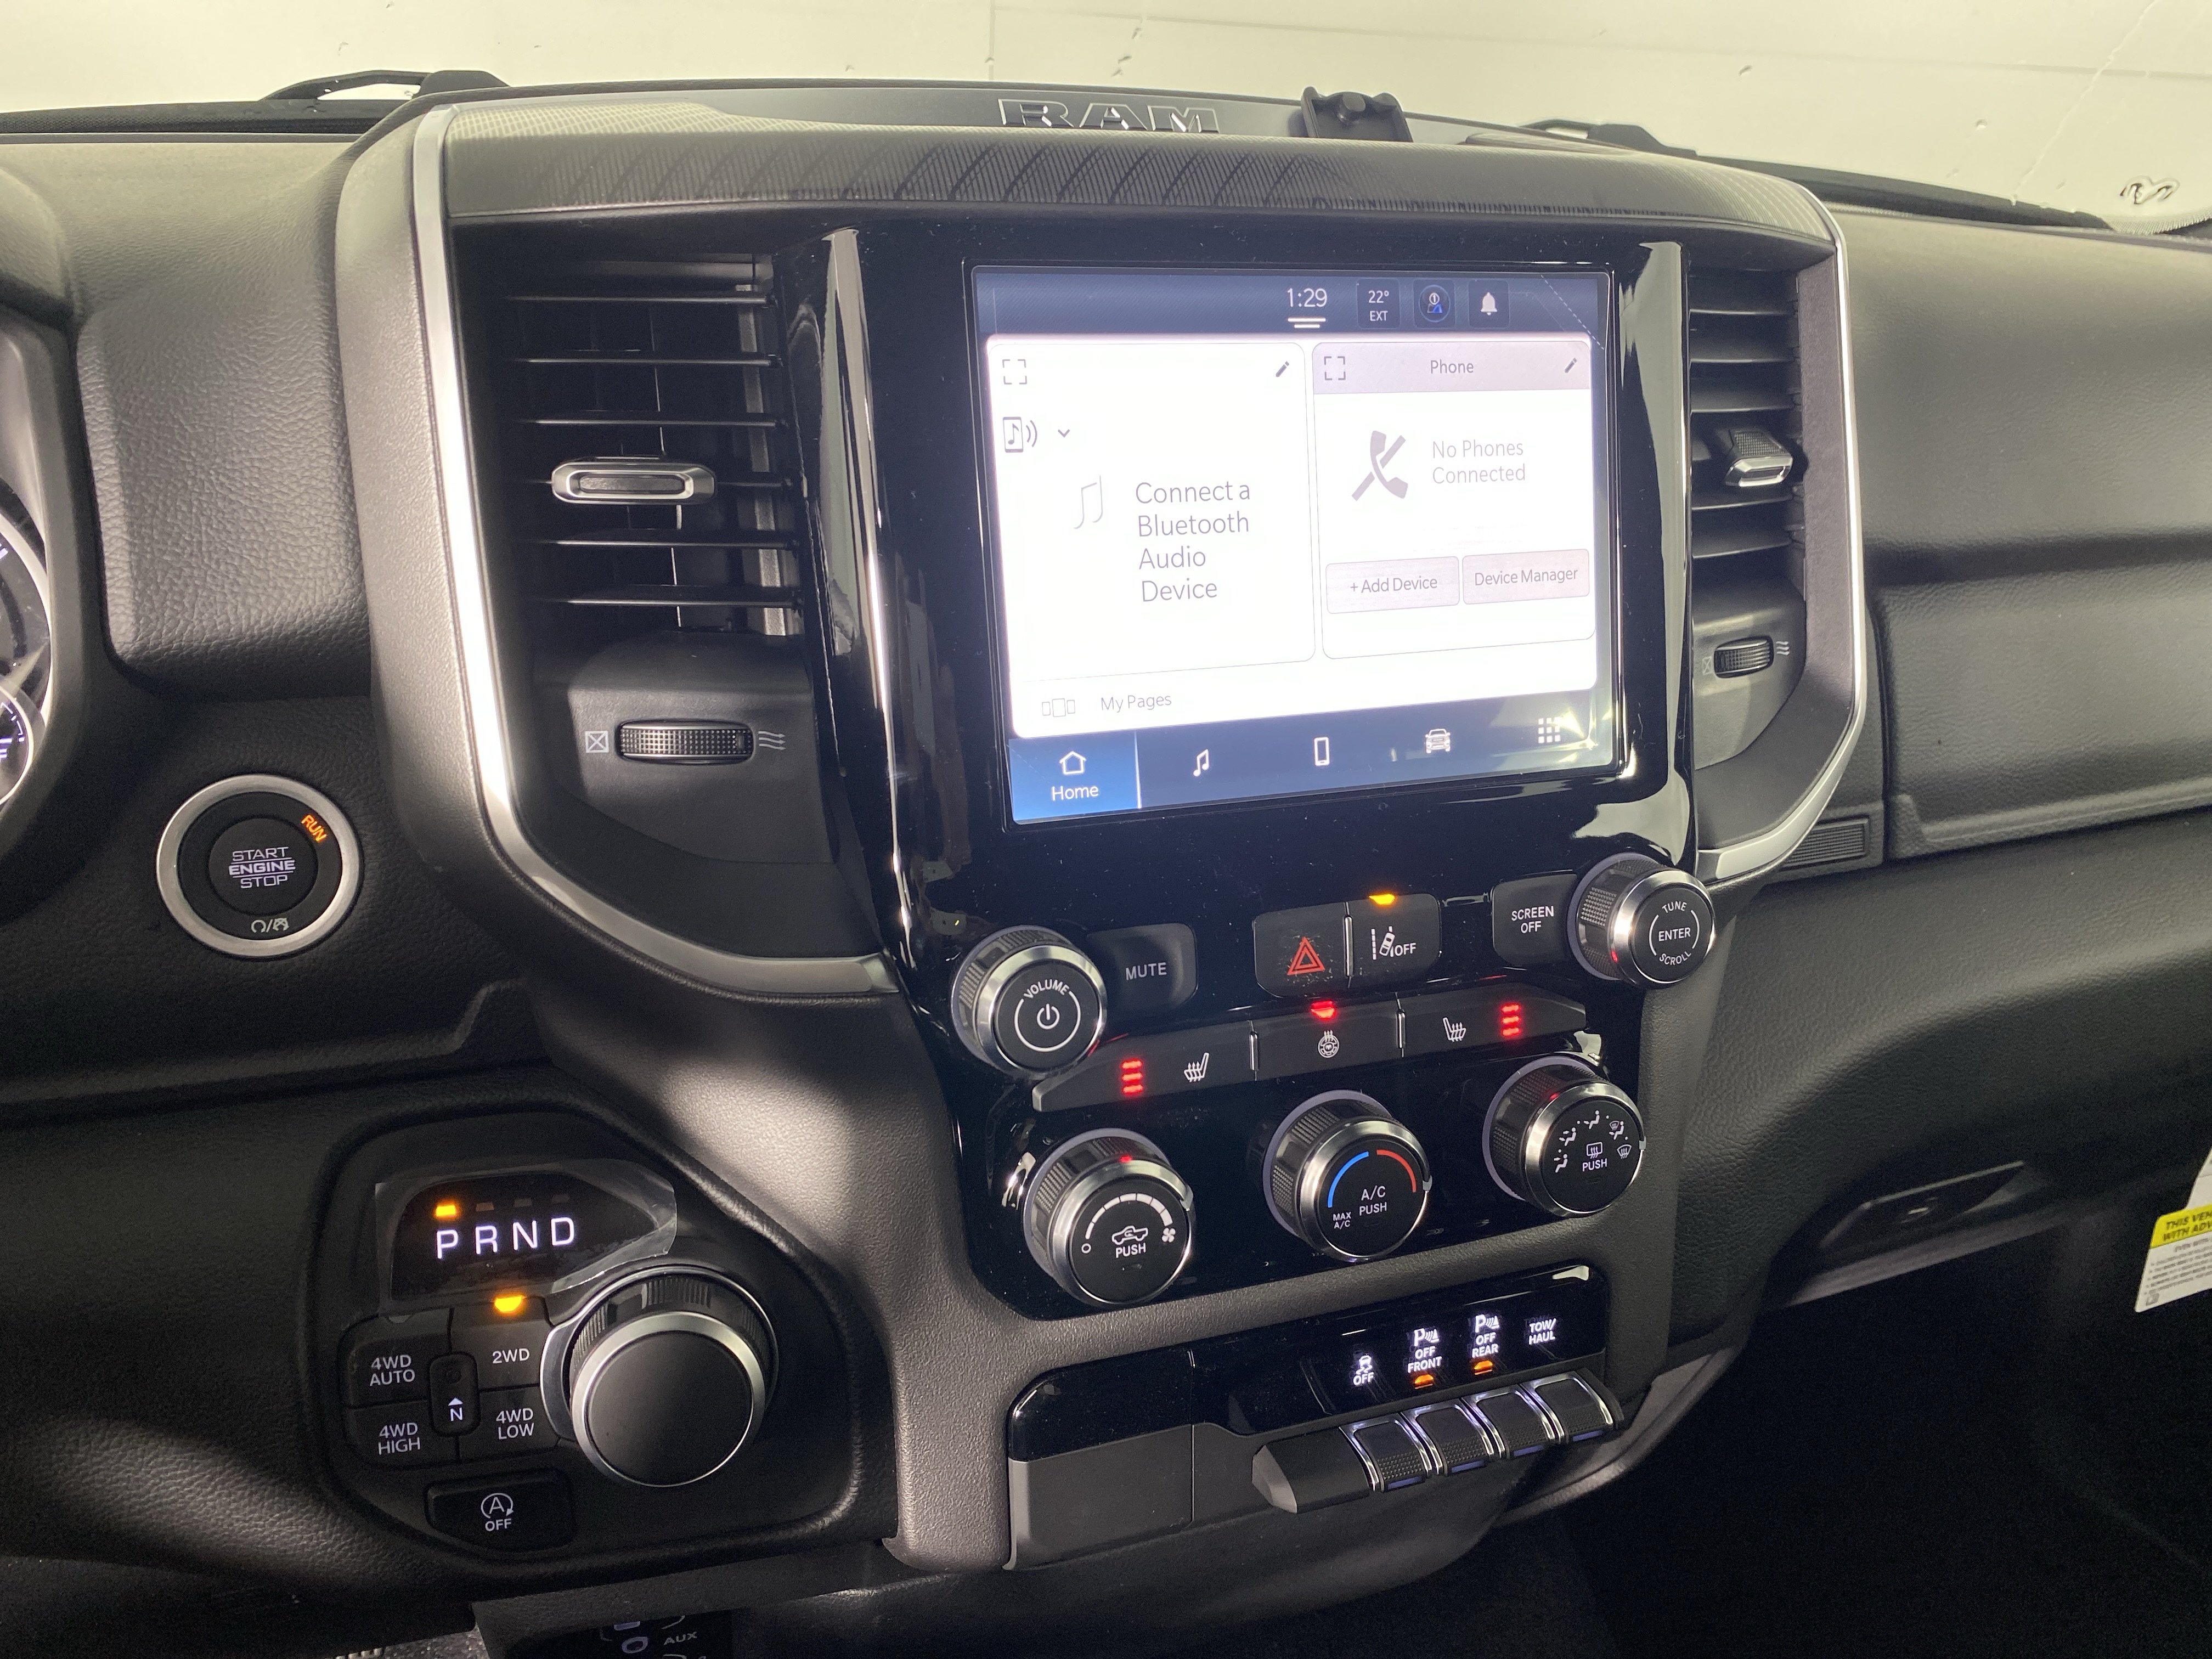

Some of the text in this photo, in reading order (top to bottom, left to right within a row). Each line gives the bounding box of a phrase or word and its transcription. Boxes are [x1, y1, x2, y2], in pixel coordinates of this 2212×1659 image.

[998, 98, 1221, 133] RAM
[1287, 287, 1328, 308] 1:29
[1369, 310, 1389, 323] EXT
[1430, 359, 1474, 374] Phone
[1432, 439, 1523, 459] No Phones
[1432, 463, 1526, 484] Connected
[1136, 481, 1250, 504] Connect a
[1138, 510, 1249, 537] Bluetooth
[1139, 545, 1206, 570] Audio
[1361, 578, 1390, 594] Add
[1393, 575, 1438, 591] Device
[1474, 568, 1578, 586] Device Manager
[1142, 577, 1217, 602] Device
[1101, 695, 1172, 713] My Pages
[1051, 785, 1099, 802] Home
[301, 814, 328, 842] RUN
[232, 847, 289, 862] START
[228, 860, 296, 876] ENGINE
[240, 875, 288, 889] STOP
[1511, 906, 1554, 921] SCREEN
[1661, 900, 1688, 915] TUNE
[1520, 921, 1542, 934] OFF
[1658, 927, 1691, 942] ENTER
[1394, 942, 1417, 956] OFF
[1658, 950, 1692, 966] SCROLL
[1125, 962, 1167, 981] MUTE
[1023, 978, 1071, 1000] VOLUME
[1582, 1158, 1608, 1172] PUSH
[1361, 1185, 1386, 1201] A/C
[1333, 1211, 1352, 1221] MAX
[1359, 1201, 1387, 1216] PUSH
[1334, 1220, 1351, 1230] A/C
[2166, 1217, 2189, 1230] THIS
[436, 1216, 575, 1259] P R N D
[1115, 1243, 1147, 1259] PUSH
[1529, 1318, 1557, 1333] TOW/
[1475, 1333, 1496, 1346] OFF
[1528, 1331, 1556, 1346] HAUL
[492, 1347, 531, 1365] 2WD
[1414, 1346, 1436, 1359] OFF
[1471, 1344, 1499, 1359] REAR
[371, 1355, 412, 1370] 4WD
[1407, 1356, 1443, 1373] FRONT
[370, 1369, 415, 1386] AUTO
[1353, 1372, 1374, 1386] OFF
[450, 1406, 463, 1422] N
[495, 1407, 534, 1425] 4WD
[379, 1422, 419, 1440] 4WD
[498, 1422, 535, 1440] LOW
[377, 1436, 421, 1456] HIGH
[484, 1517, 512, 1532] OFF
[663, 1631, 698, 1645] AUX
